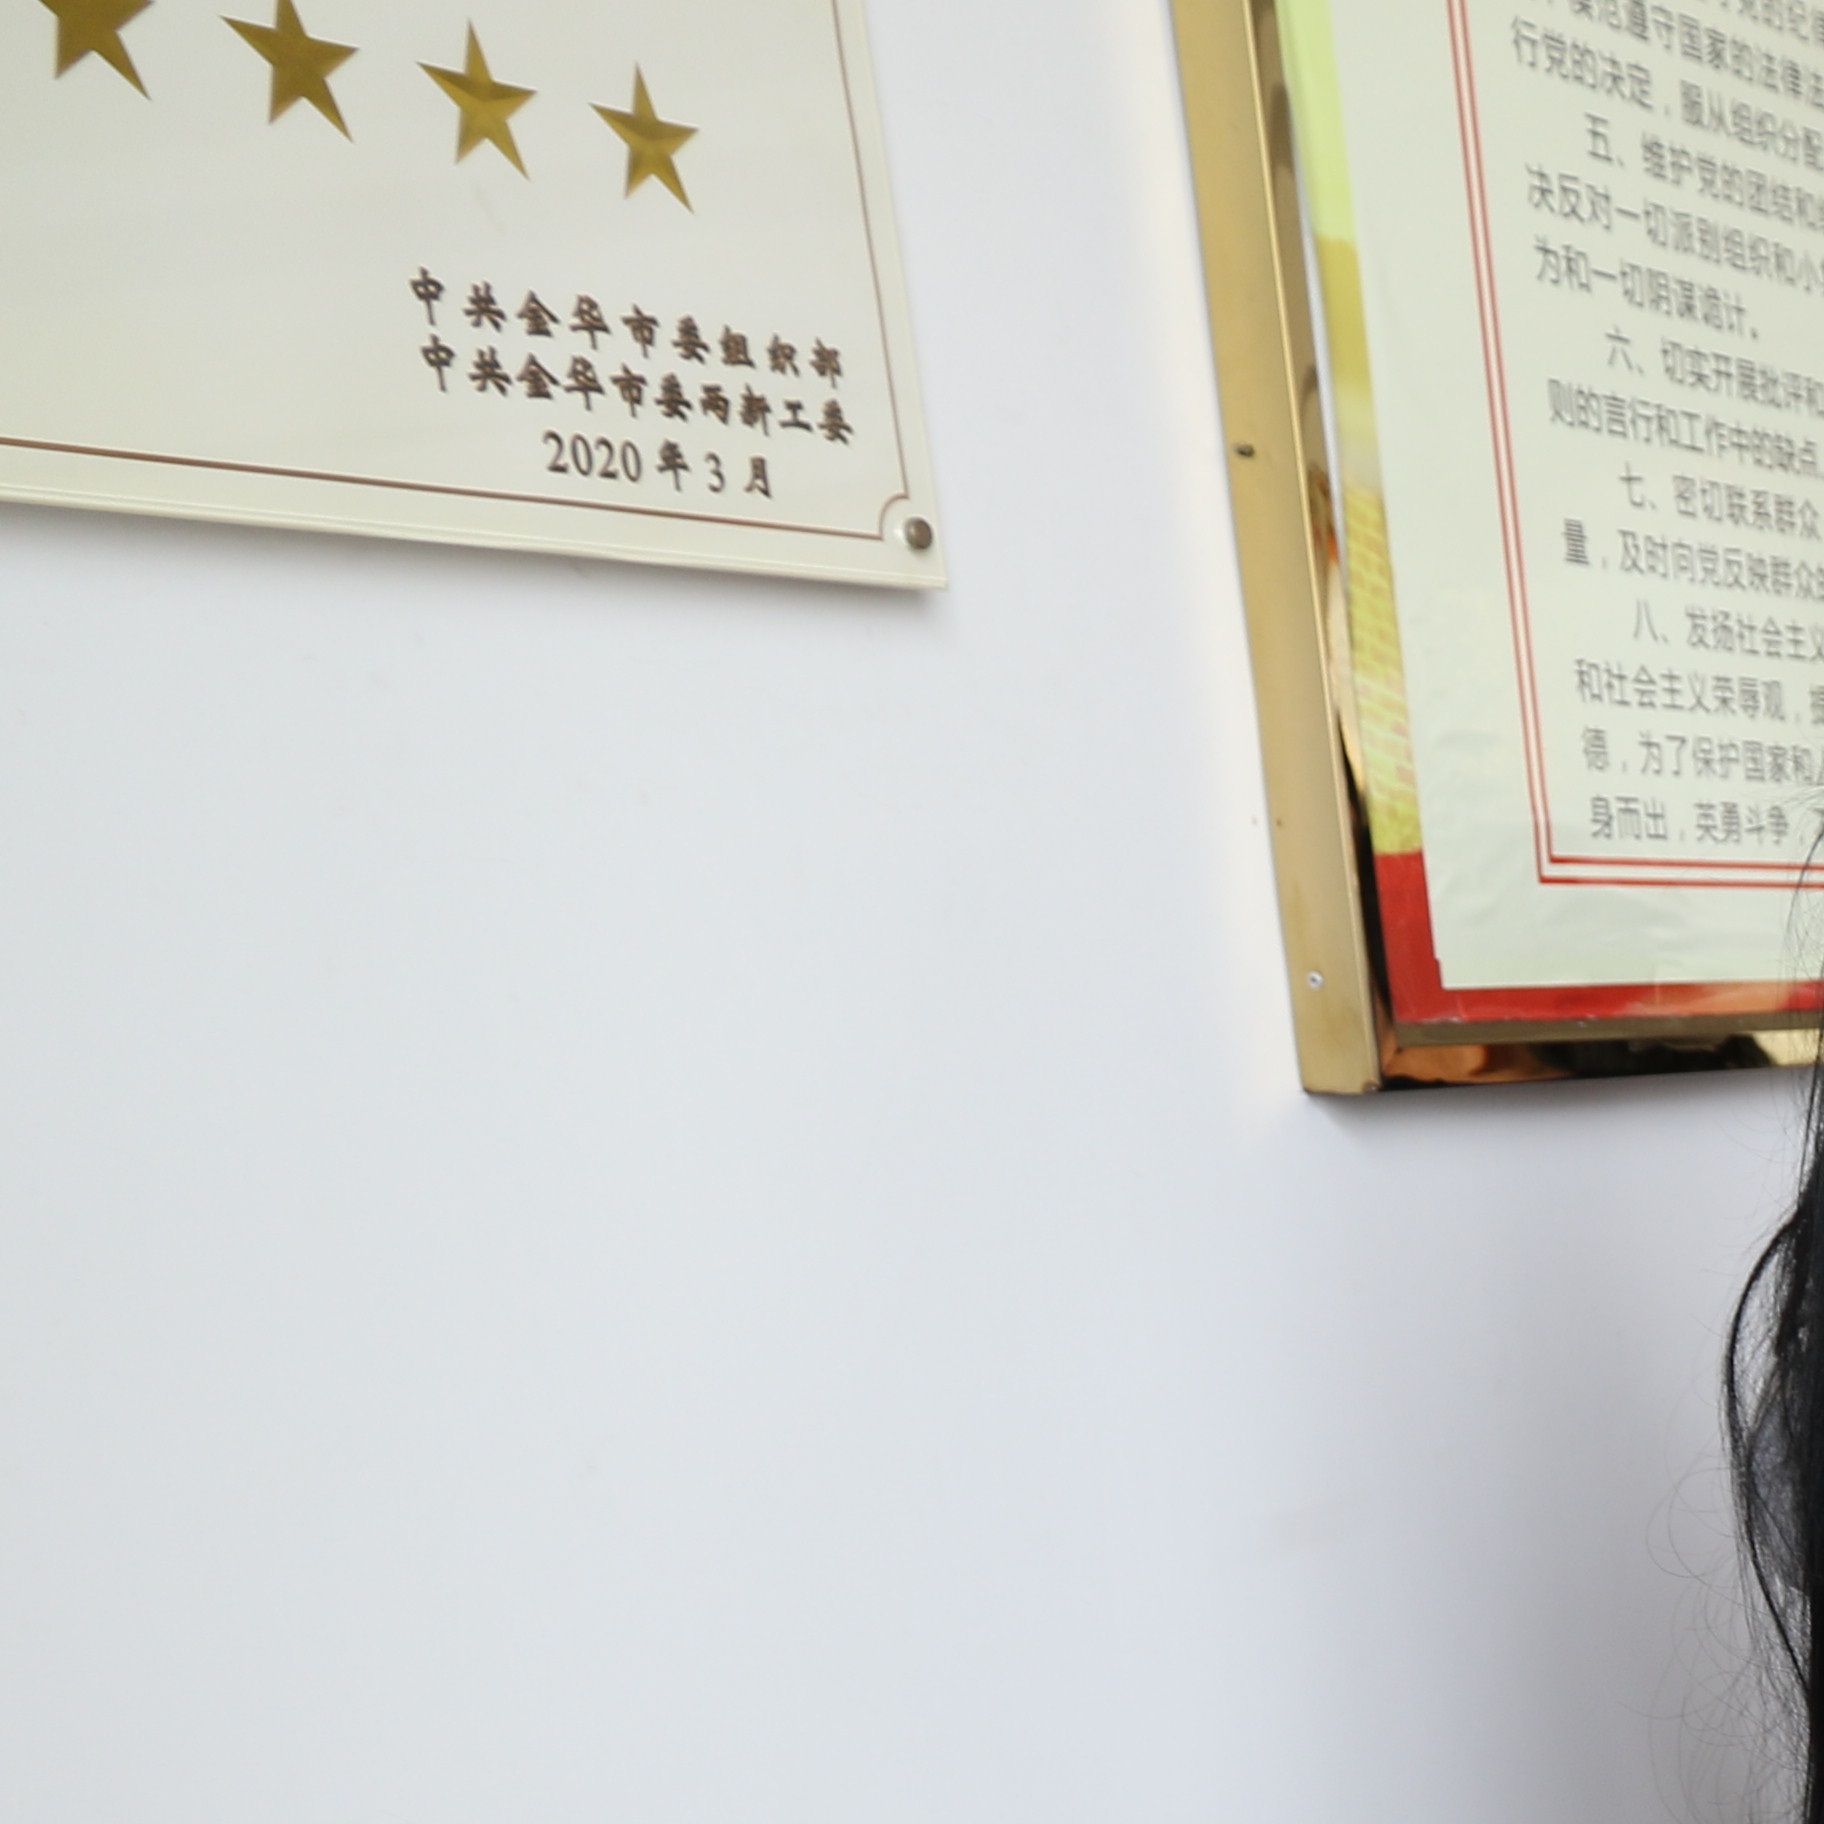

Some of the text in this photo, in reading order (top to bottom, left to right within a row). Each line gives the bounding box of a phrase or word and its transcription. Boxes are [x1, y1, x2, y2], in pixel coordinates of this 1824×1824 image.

[409, 266, 845, 389] 中共金华市委组织部
[419, 334, 856, 446] 中共金华市委两新工委
